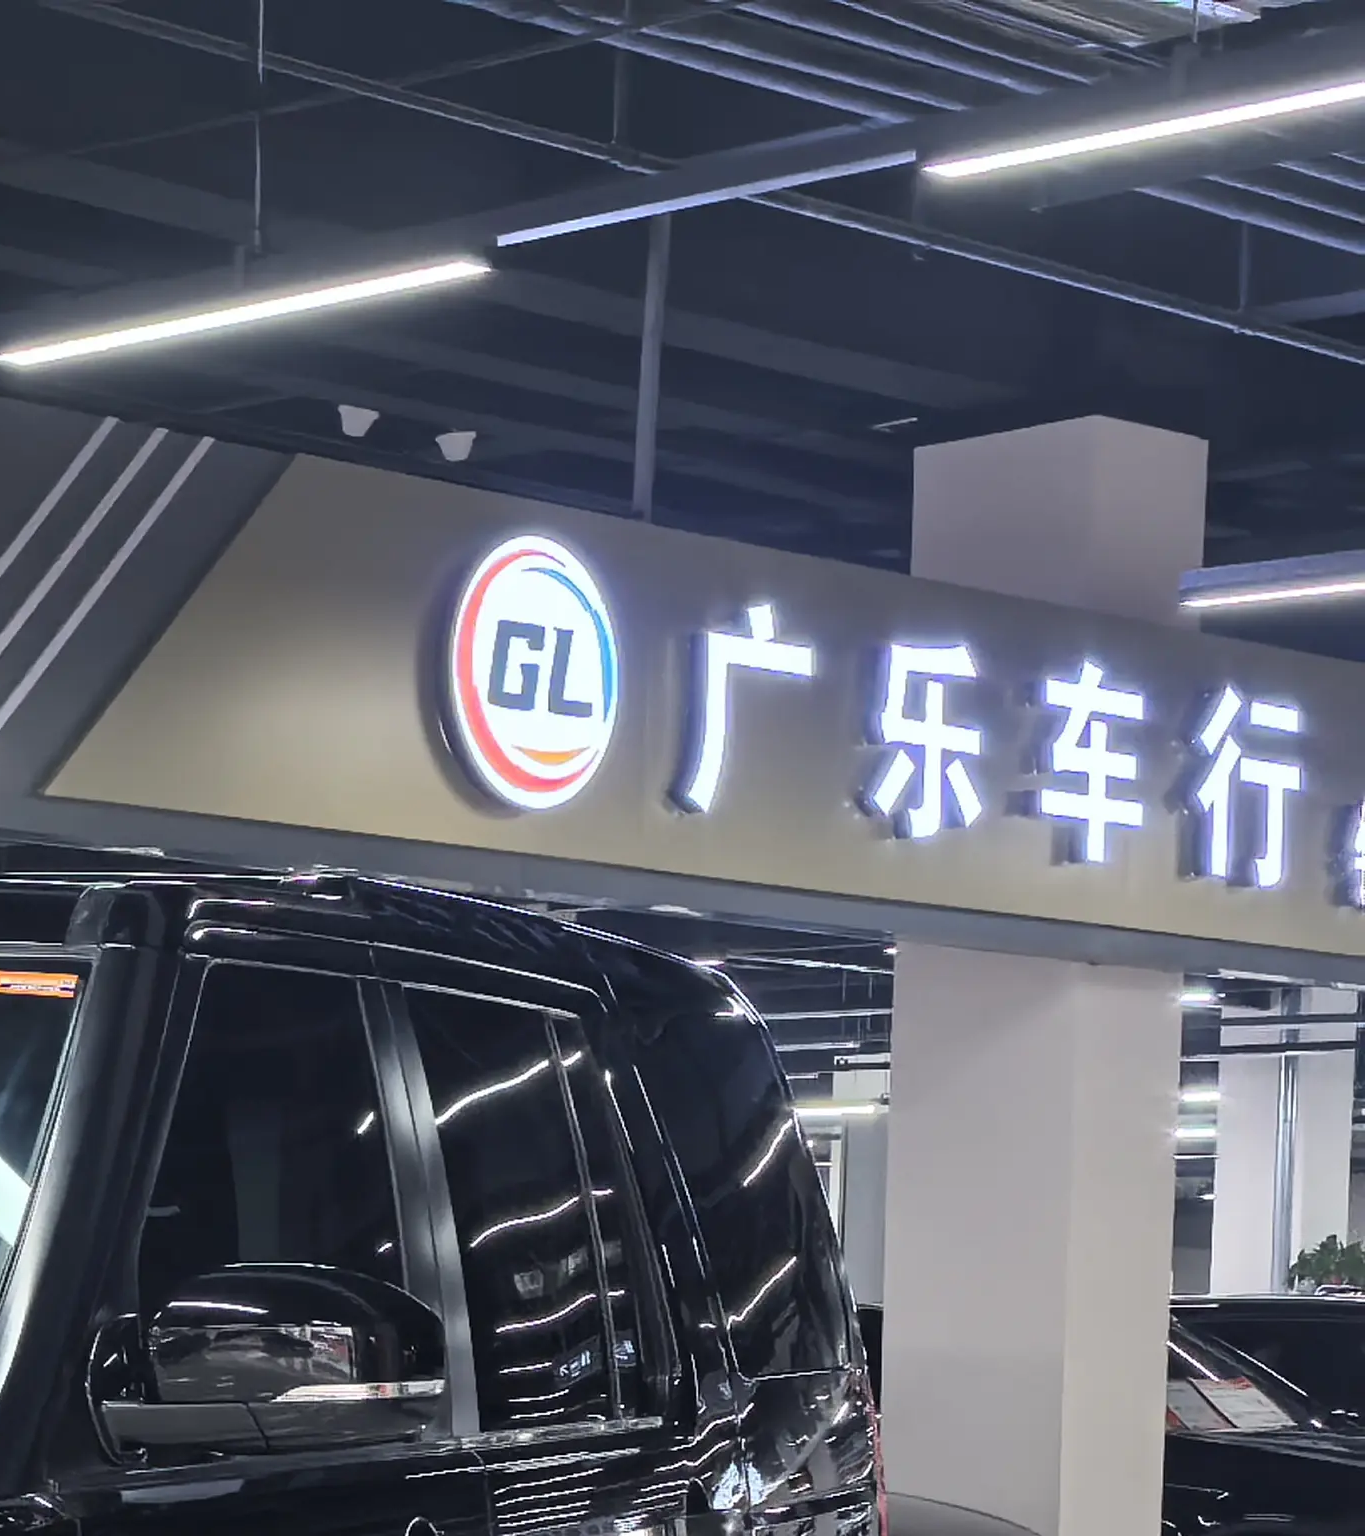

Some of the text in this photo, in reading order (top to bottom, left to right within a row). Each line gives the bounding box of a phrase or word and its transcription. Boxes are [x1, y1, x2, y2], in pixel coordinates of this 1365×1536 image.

[488, 618, 594, 718] GL
[682, 604, 1302, 888] 广乐车行
